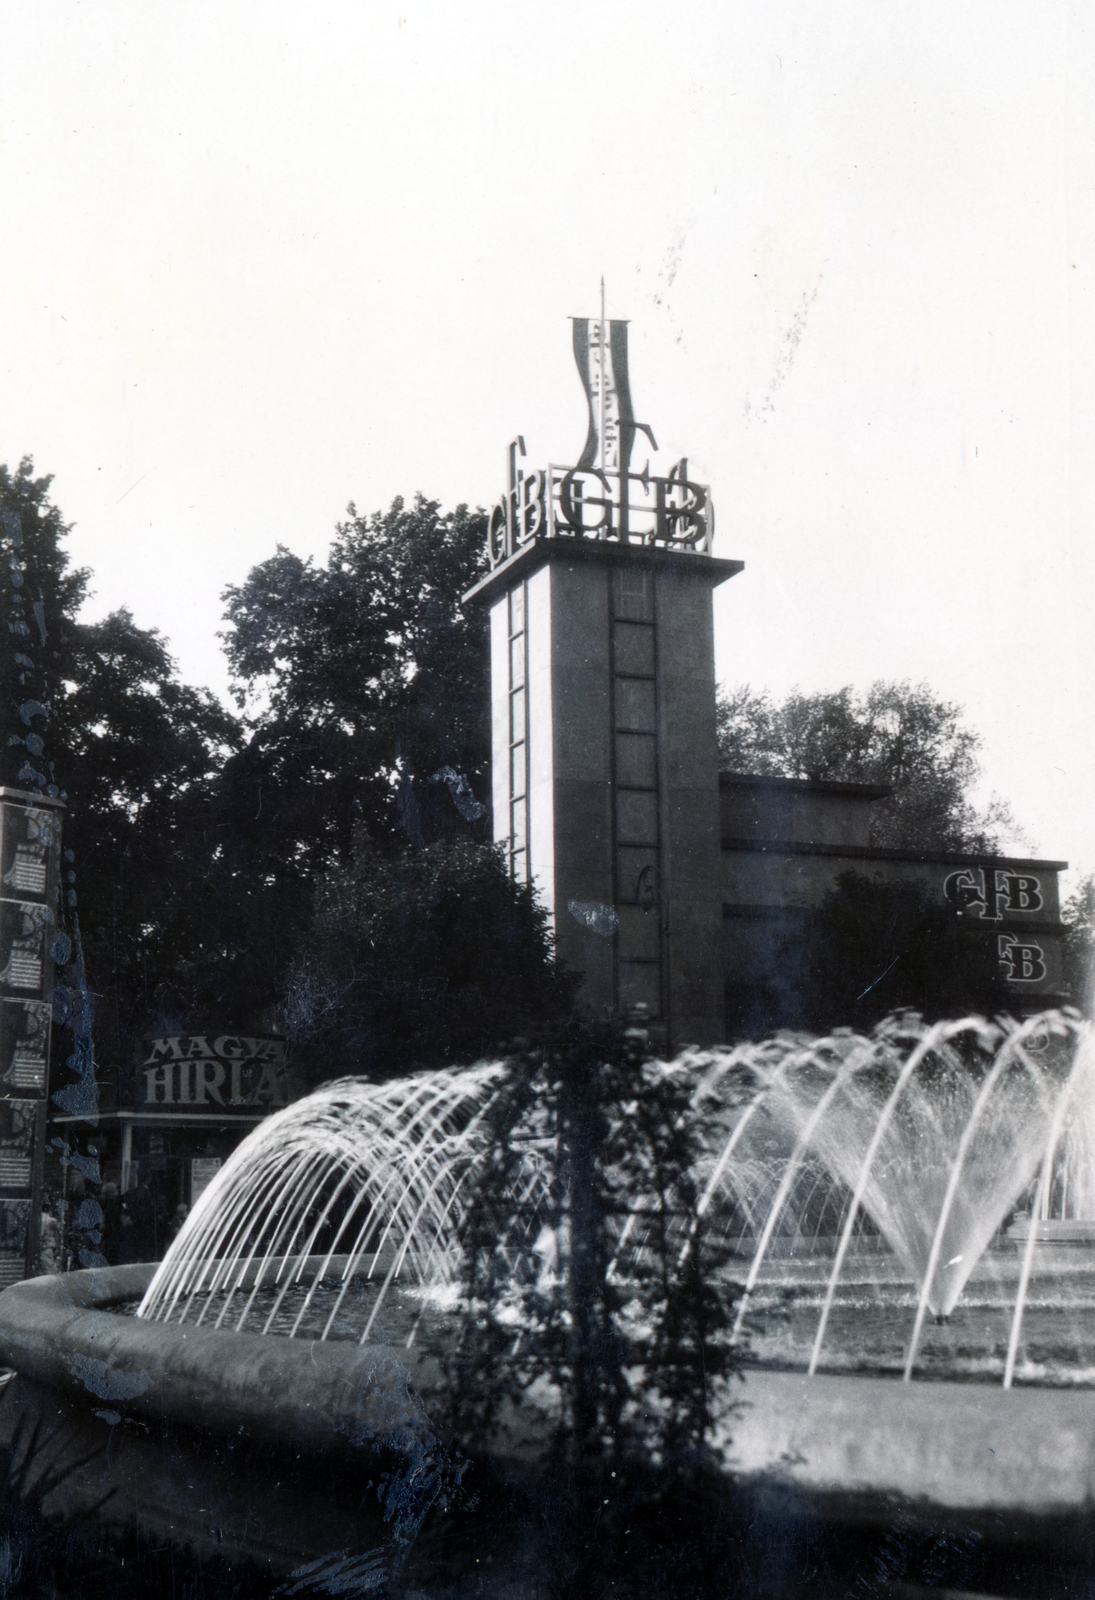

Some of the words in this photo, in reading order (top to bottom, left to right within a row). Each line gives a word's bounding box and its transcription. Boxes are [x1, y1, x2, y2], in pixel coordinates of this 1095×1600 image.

[558, 419, 706, 546] GFB
[943, 864, 1043, 920] GFB
[997, 930, 1046, 982] FB
[143, 1035, 281, 1064] MAGYA
[143, 1058, 288, 1107] HIRLA
